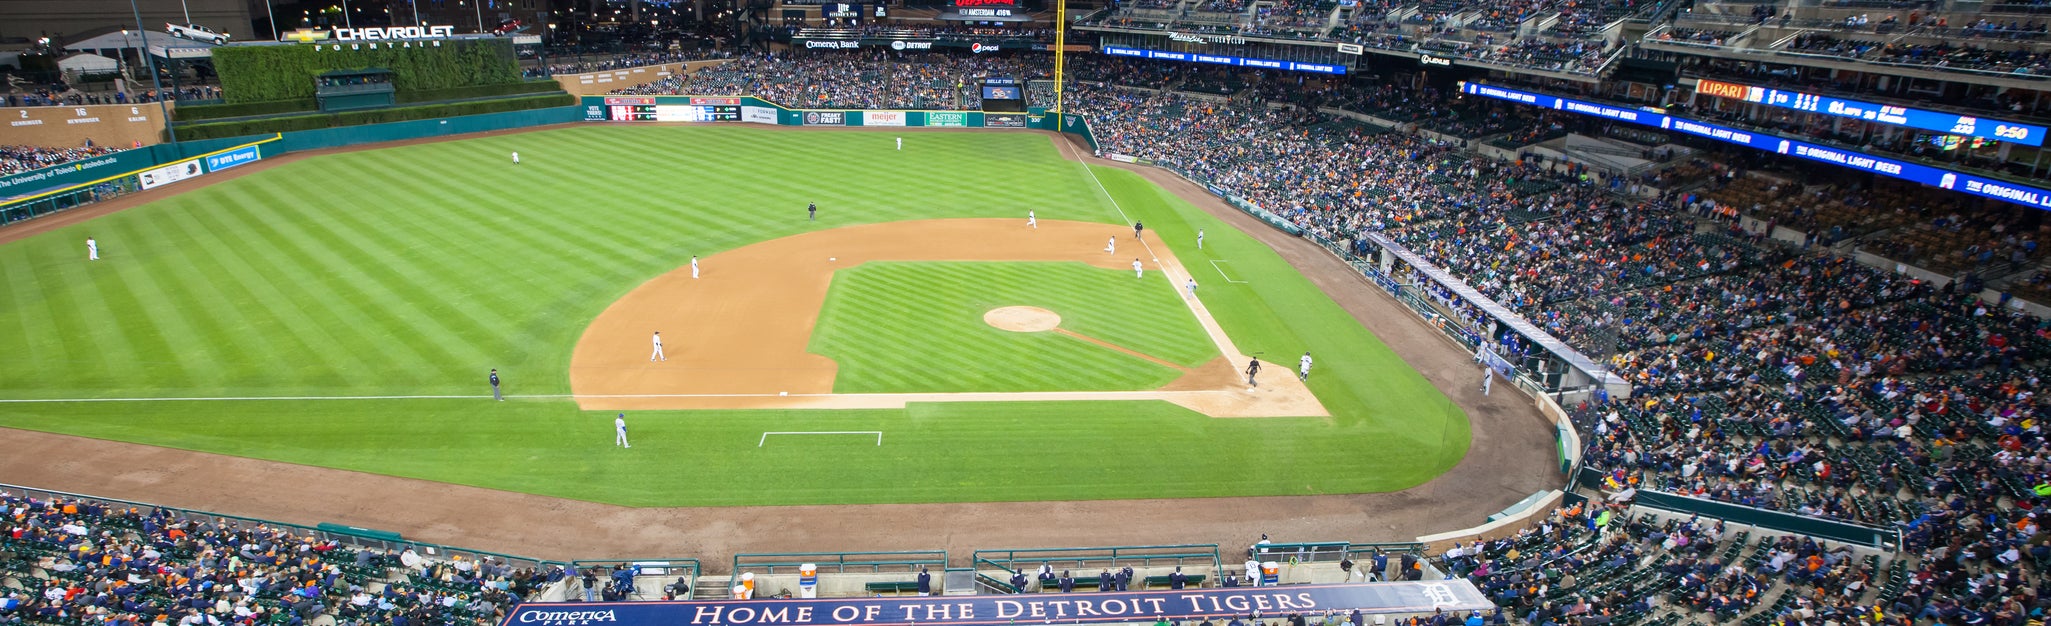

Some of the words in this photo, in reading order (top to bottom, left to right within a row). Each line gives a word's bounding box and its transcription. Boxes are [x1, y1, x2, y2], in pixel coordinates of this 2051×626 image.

[336, 25, 454, 40] CHEVROLET
[315, 40, 440, 52] FOUNTAIN
[840, 40, 859, 48] Bank
[1702, 82, 1742, 98] LIPARI
[20, 110, 28, 118] 2
[75, 108, 88, 116] 16
[132, 107, 139, 115] 6
[872, 112, 896, 121] meijer
[930, 112, 962, 120] EASTERN
[220, 155, 233, 165] DTE
[233, 151, 254, 161] Energy
[1807, 148, 1846, 163] ORIGINAL
[1847, 156, 1875, 168] LIGHT
[1875, 161, 1902, 174] BEER
[11, 172, 46, 185] University
[47, 170, 55, 178] of
[54, 166, 76, 176] Toledo
[82, 157, 117, 170] utoledo.edu
[1966, 180, 1983, 190] THE
[1982, 184, 2038, 204] ORIGINAL
[691, 606, 813, 624] HOME
[832, 604, 881, 622] OF
[899, 602, 975, 620] THE
[995, 597, 1166, 618] DETROIT
[1182, 592, 1317, 614] TIGERS
